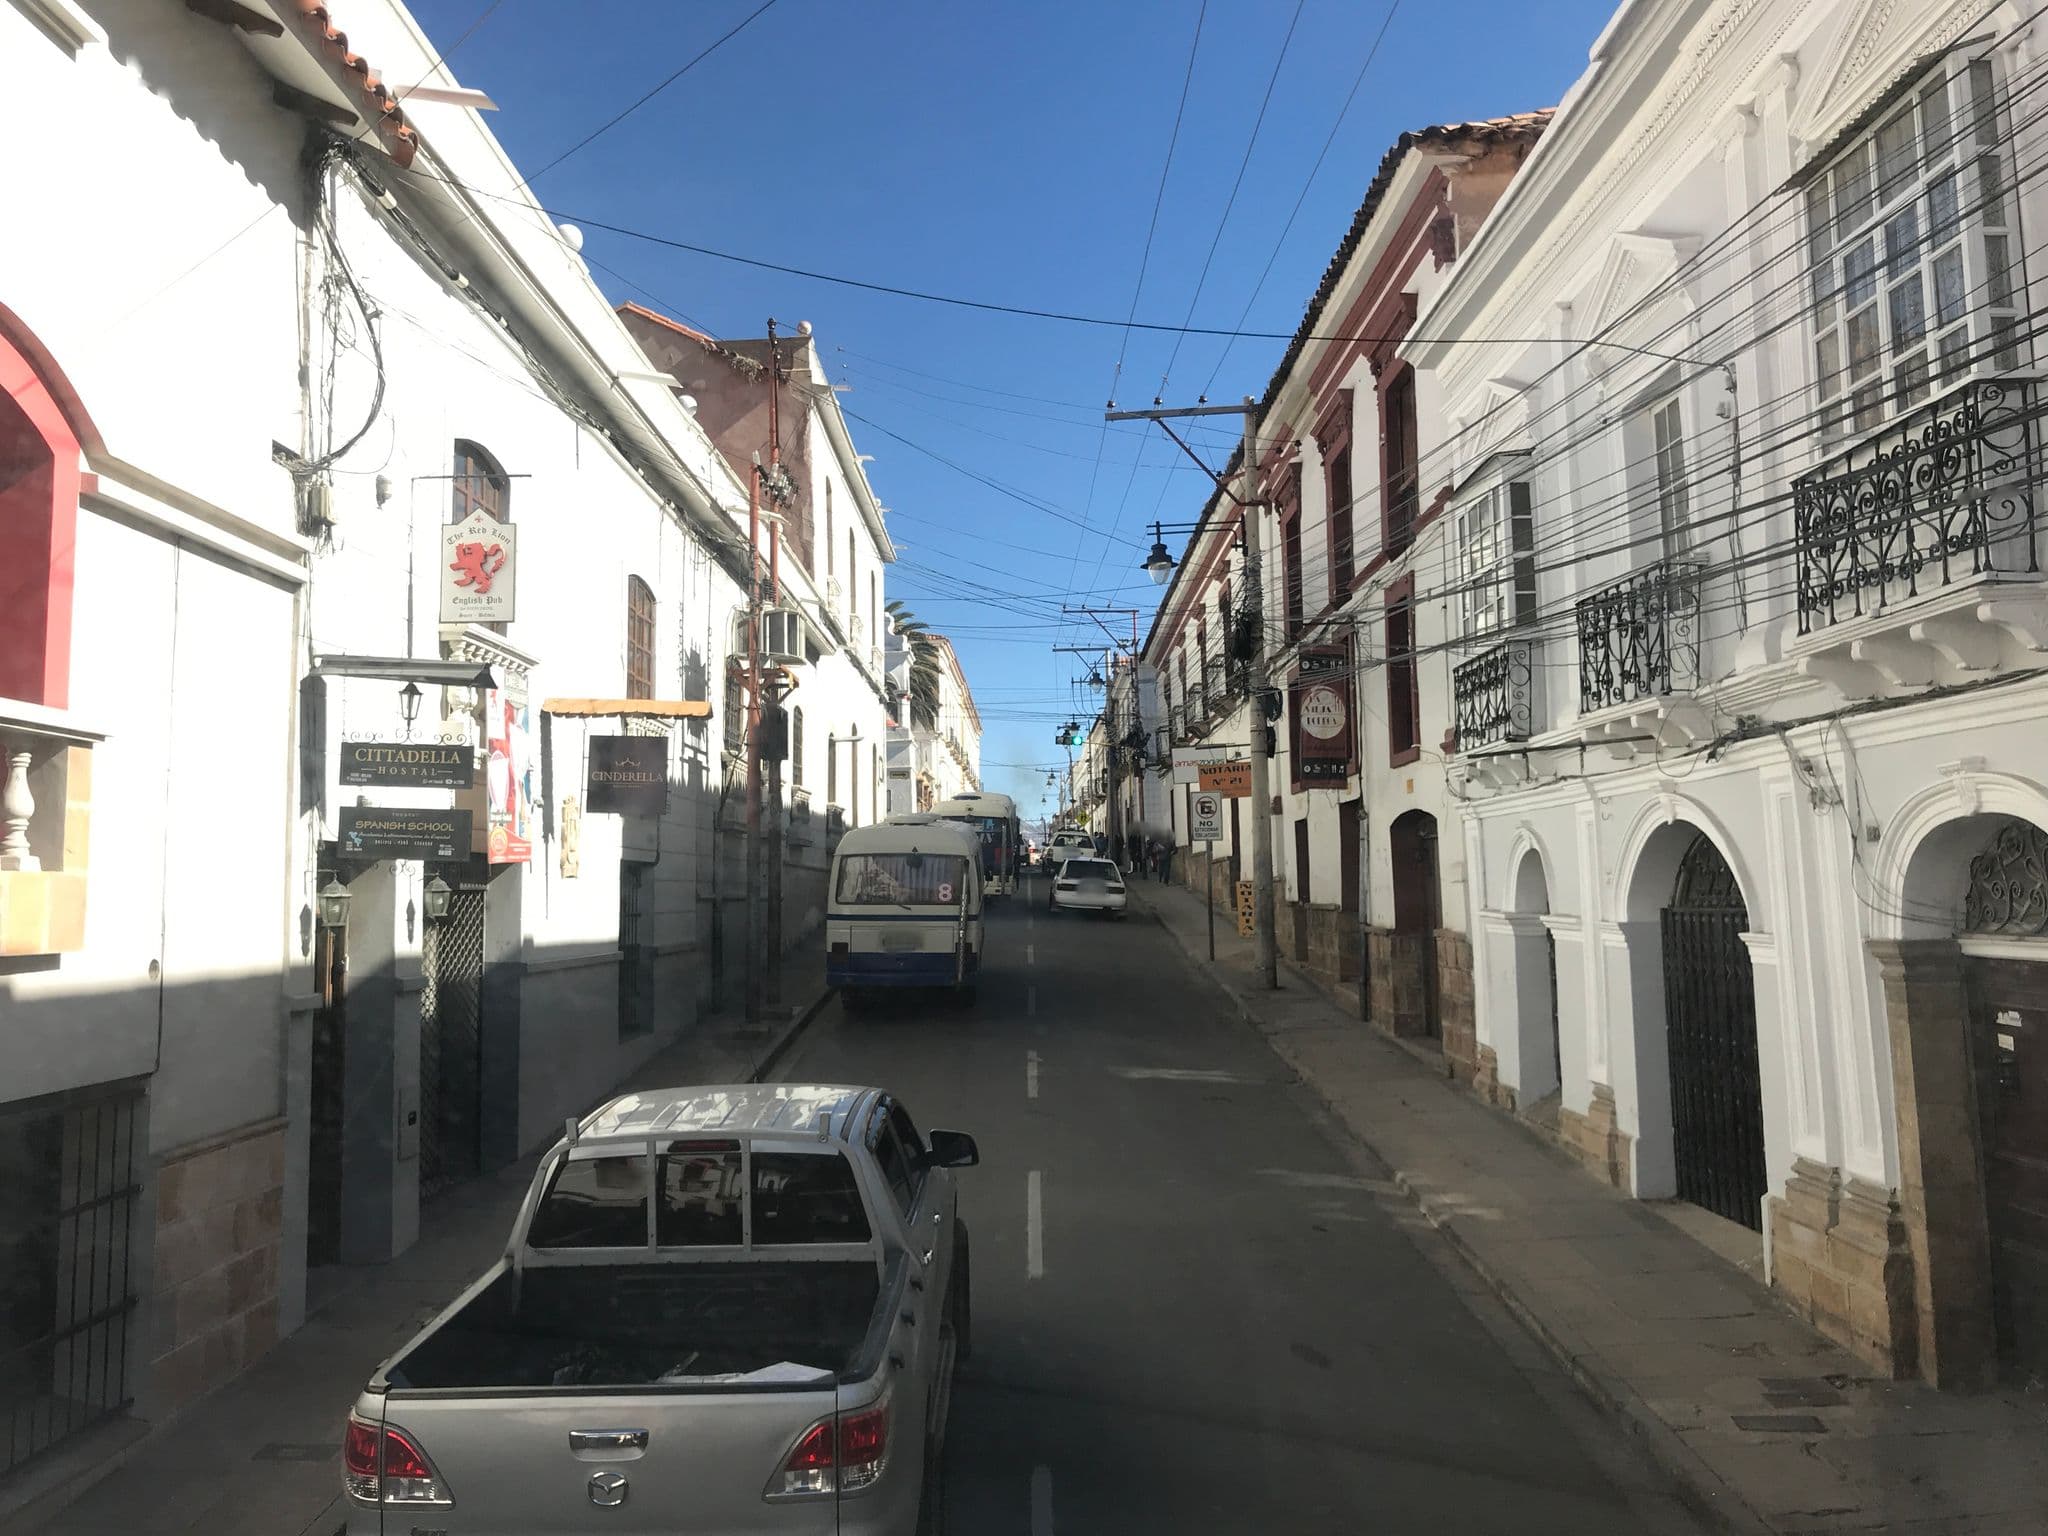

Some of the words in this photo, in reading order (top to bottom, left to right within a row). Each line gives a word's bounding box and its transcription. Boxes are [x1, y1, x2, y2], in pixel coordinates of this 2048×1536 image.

[446, 531, 465, 546] The
[469, 526, 487, 535] Red
[491, 527, 511, 545] Lion
[452, 596, 483, 605] English
[486, 596, 503, 605] Pub
[355, 748, 461, 764] CITTADELLA
[378, 766, 438, 776] HOSTAL
[1200, 765, 1252, 775] NOTARIA
[591, 770, 664, 783] CINDERELLA
[1230, 776, 1242, 785] 21
[355, 820, 406, 830] SPANISH
[407, 822, 455, 832] SCHOOL
[938, 883, 952, 901] 8
[1239, 883, 1253, 931] NOTARIA
